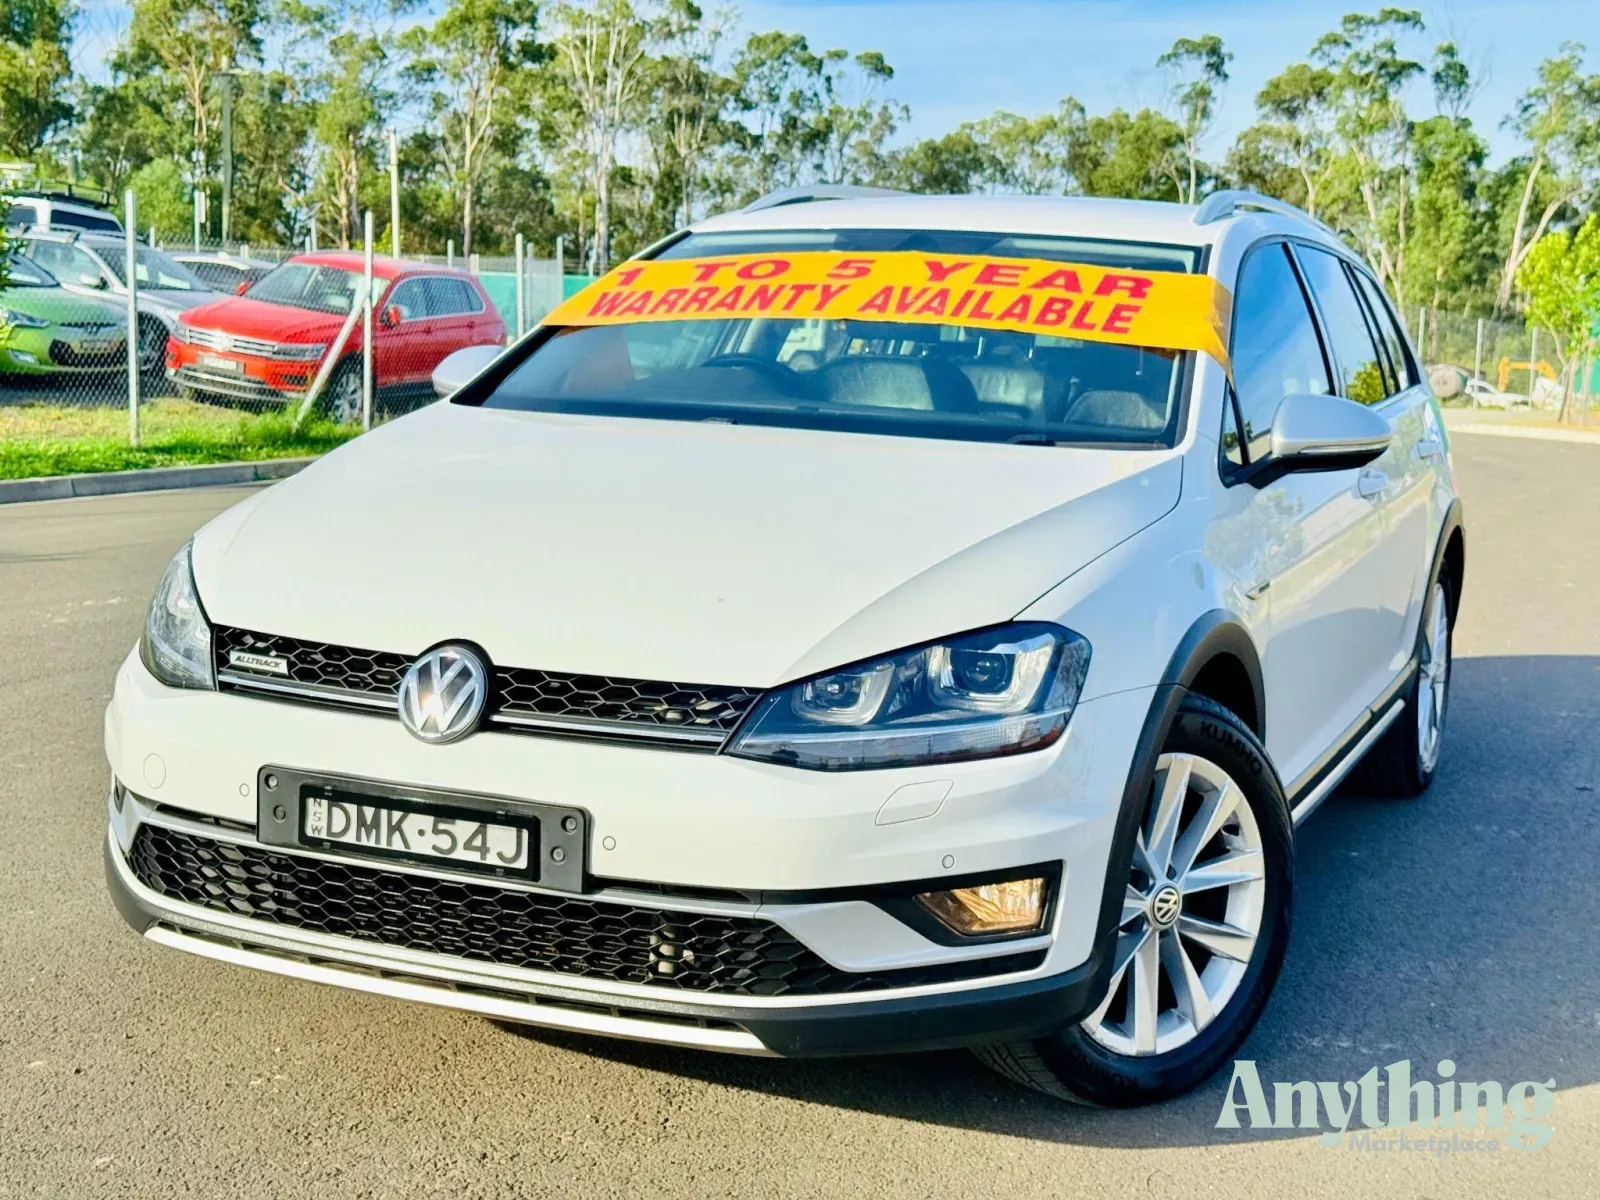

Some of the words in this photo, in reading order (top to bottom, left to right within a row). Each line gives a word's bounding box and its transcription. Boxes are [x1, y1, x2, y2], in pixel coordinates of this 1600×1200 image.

[616, 267, 647, 287] 1
[693, 259, 792, 283] TO
[826, 259, 876, 280] 5
[923, 259, 1154, 300] YEAR
[587, 284, 852, 317] WARRANTY
[857, 285, 1143, 335] AVAILABLE
[234, 655, 283, 669] ALLTRACK
[1200, 719, 1263, 775] KUMHO
